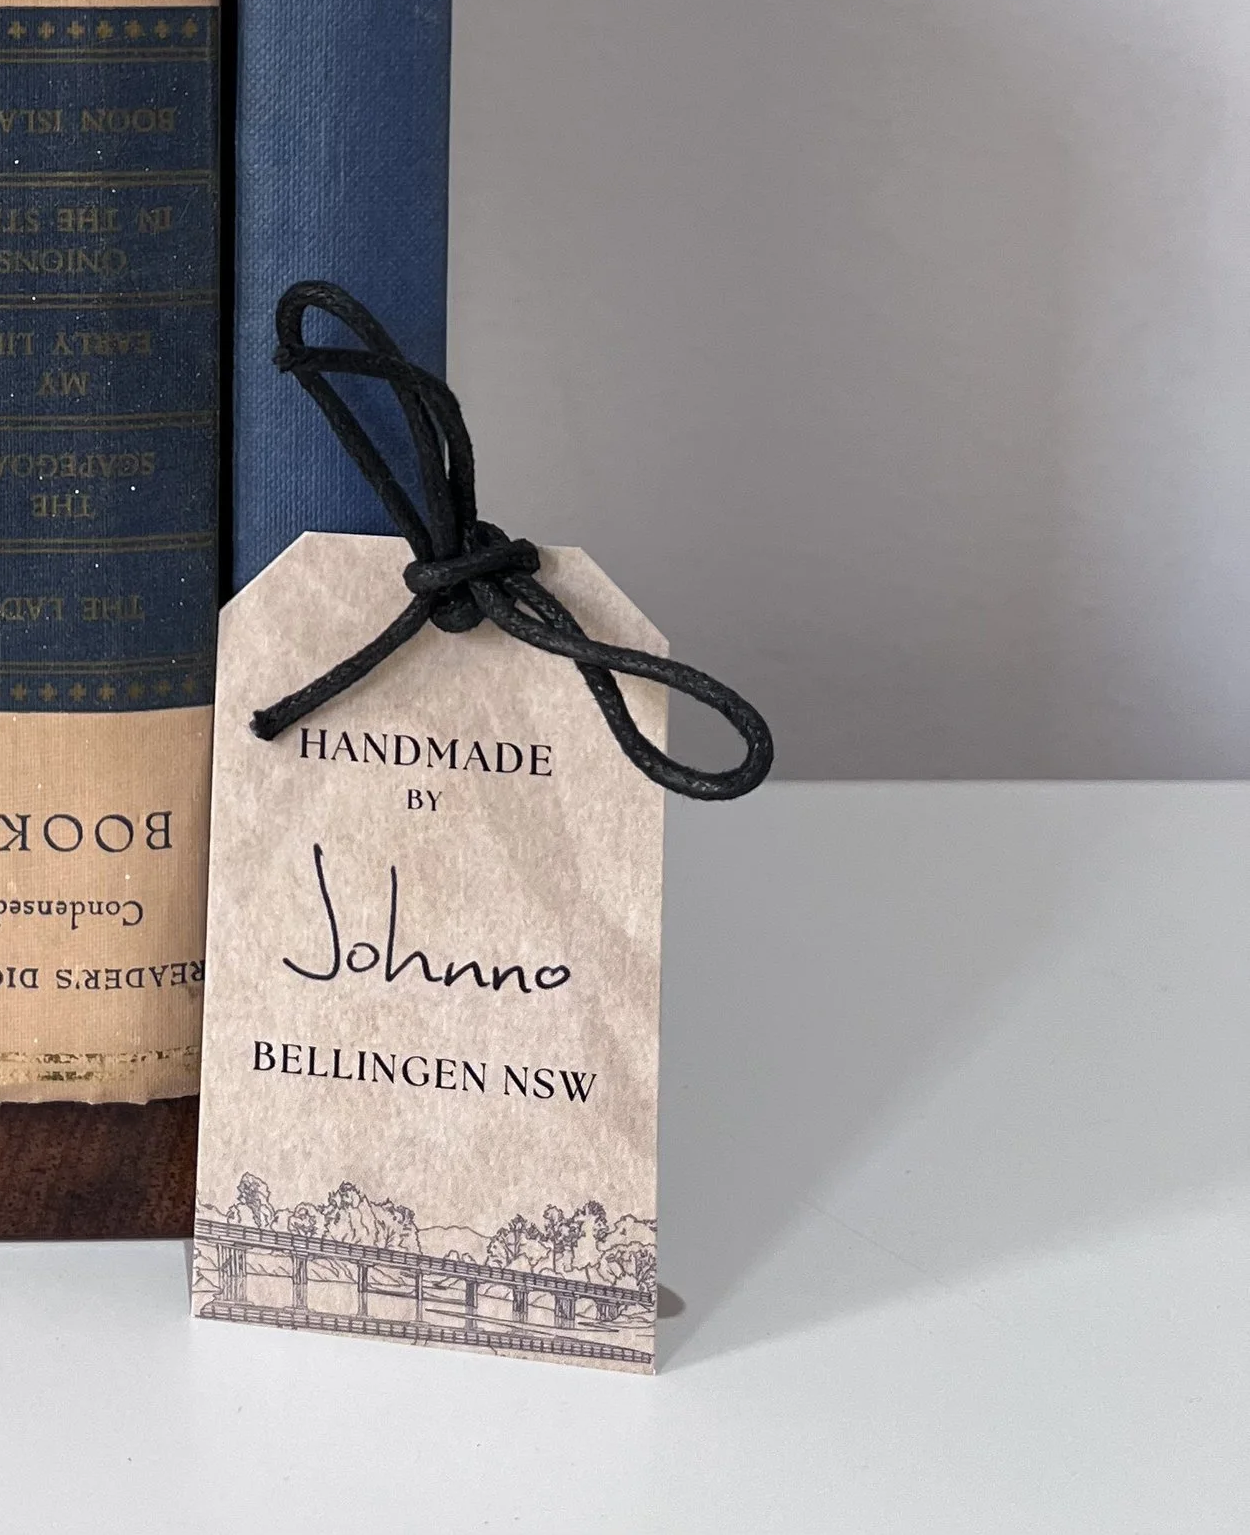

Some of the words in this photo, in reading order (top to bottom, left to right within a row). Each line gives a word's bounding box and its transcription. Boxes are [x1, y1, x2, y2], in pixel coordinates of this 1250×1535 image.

[81, 106, 177, 133] BOON
[56, 208, 122, 233] THE
[137, 206, 173, 231] IN
[53, 331, 152, 355] EARLY
[38, 371, 91, 395] MY
[31, 493, 94, 517] THE
[81, 594, 146, 621] THE
[299, 727, 553, 777] HANDMADE
[406, 788, 443, 812] BY
[282, 843, 571, 994] Johnno
[56, 959, 206, 991] READER'S
[252, 1041, 488, 1094] BELLINGEN
[502, 1064, 598, 1104] NSW
